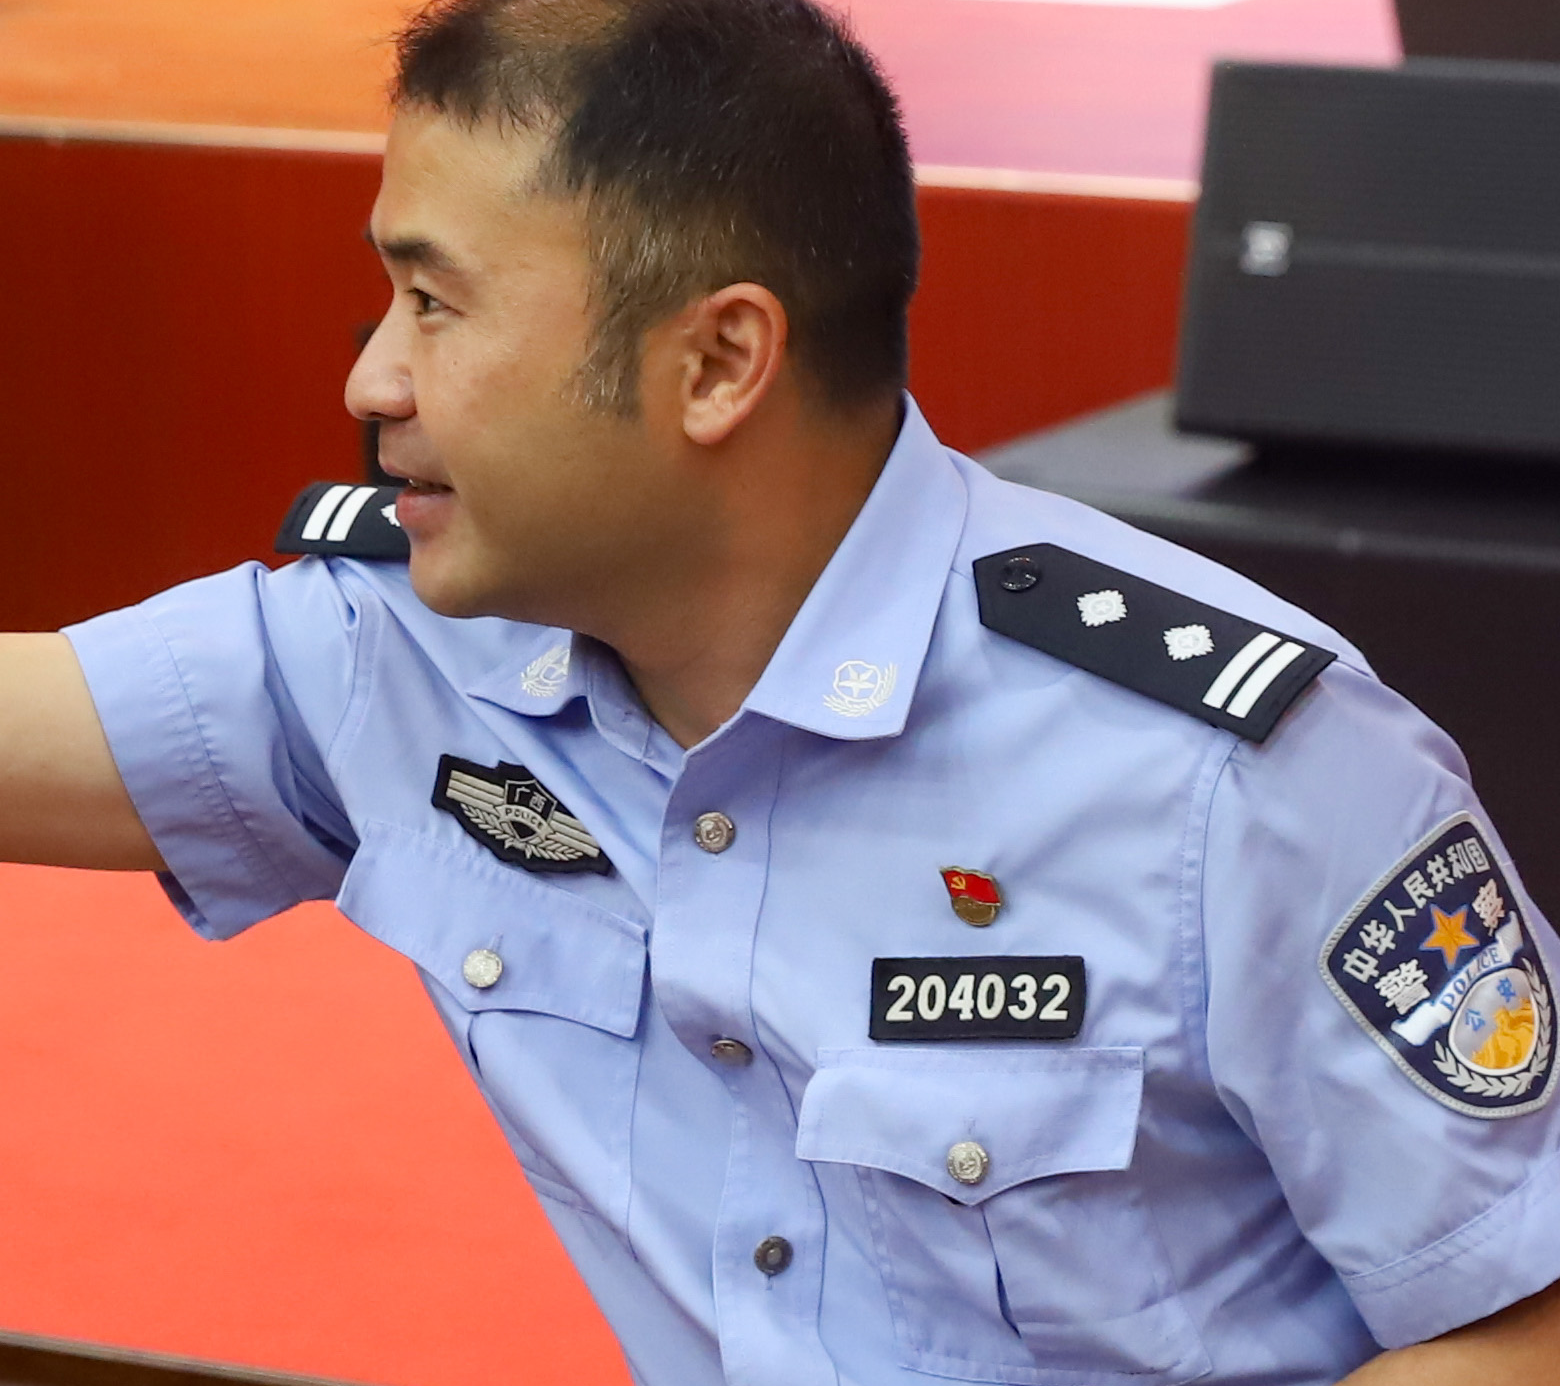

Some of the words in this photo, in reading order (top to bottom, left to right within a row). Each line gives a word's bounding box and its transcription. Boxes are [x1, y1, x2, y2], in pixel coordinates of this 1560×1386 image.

[505, 807, 544, 827] POLICE
[514, 786, 547, 812] 广西
[1343, 837, 1490, 983] 中华人民共和国
[885, 973, 1071, 1021] 204032
[1440, 946, 1502, 1012] POLICE
